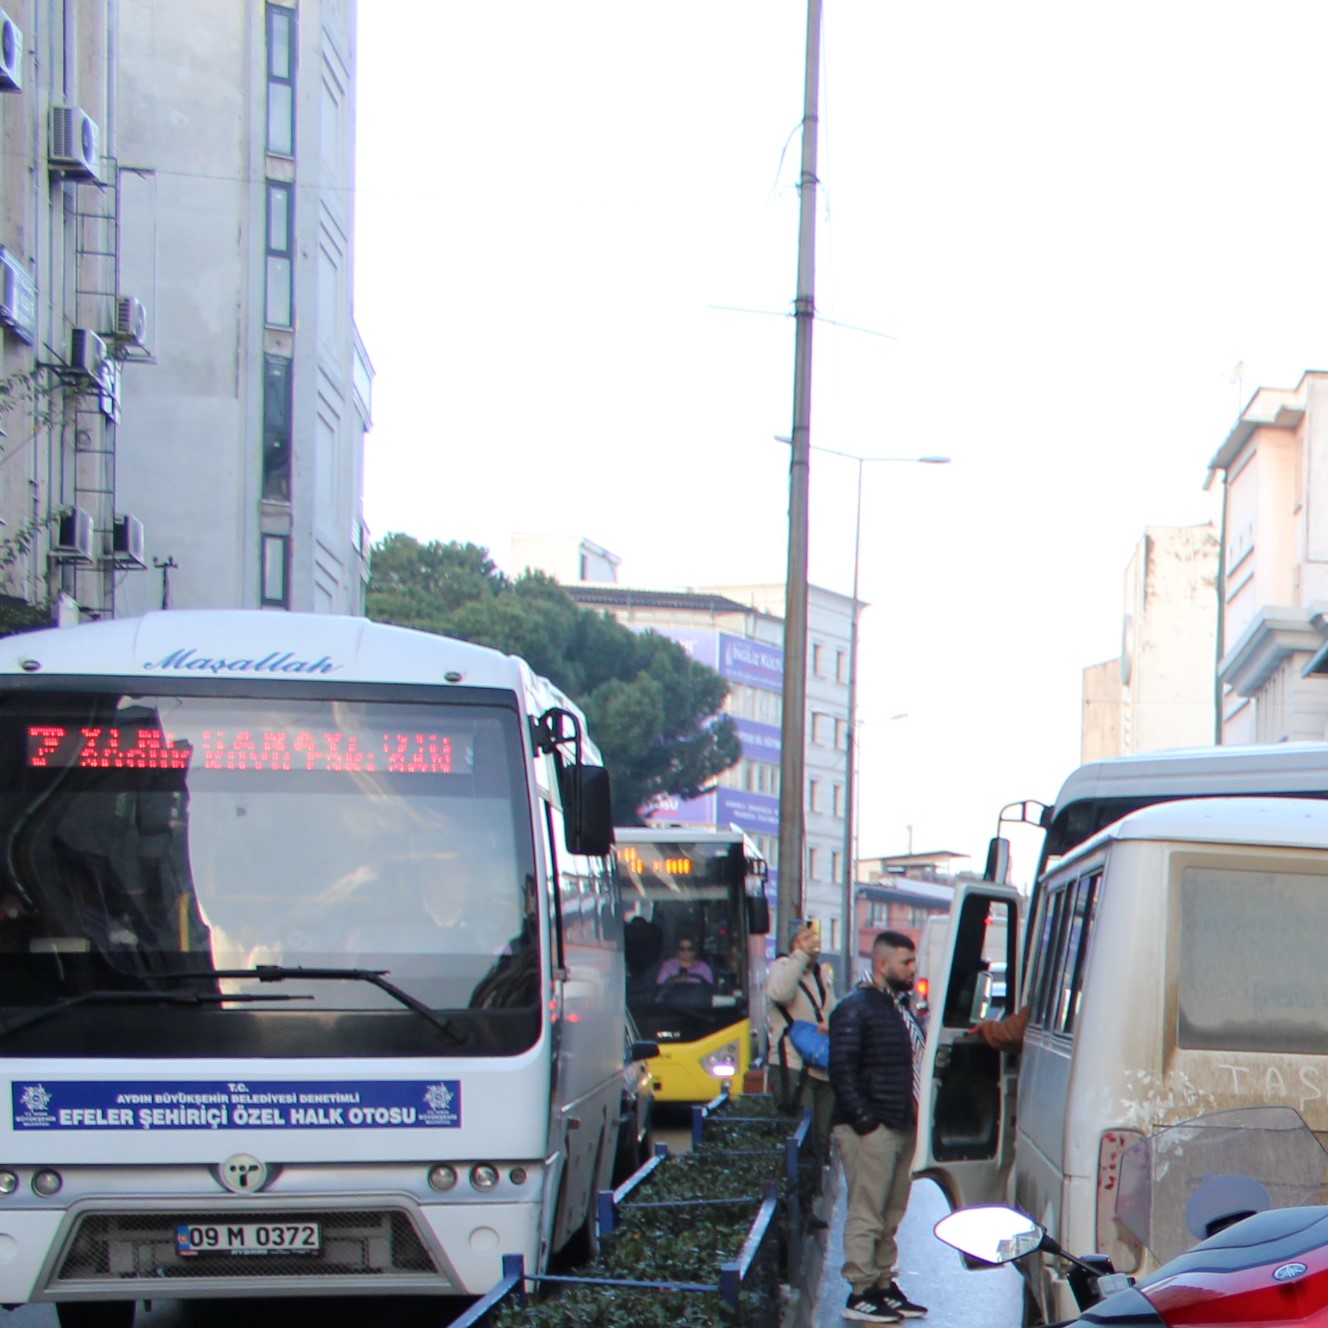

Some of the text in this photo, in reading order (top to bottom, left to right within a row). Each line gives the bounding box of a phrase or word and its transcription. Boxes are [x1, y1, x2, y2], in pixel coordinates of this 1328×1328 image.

[144, 648, 344, 675] Maşallah
[29, 727, 66, 767] 7
[117, 1092, 360, 1106] AYDIN BÜYÜKŞEHİR BELEDİYESİ DENETİMLİ
[228, 1083, 249, 1093] T.C.
[58, 1103, 416, 1129] EFELER ŞEHİRİÇİ ÖZEL HALK OTOSU
[190, 1226, 316, 1247] 09 M 0372
